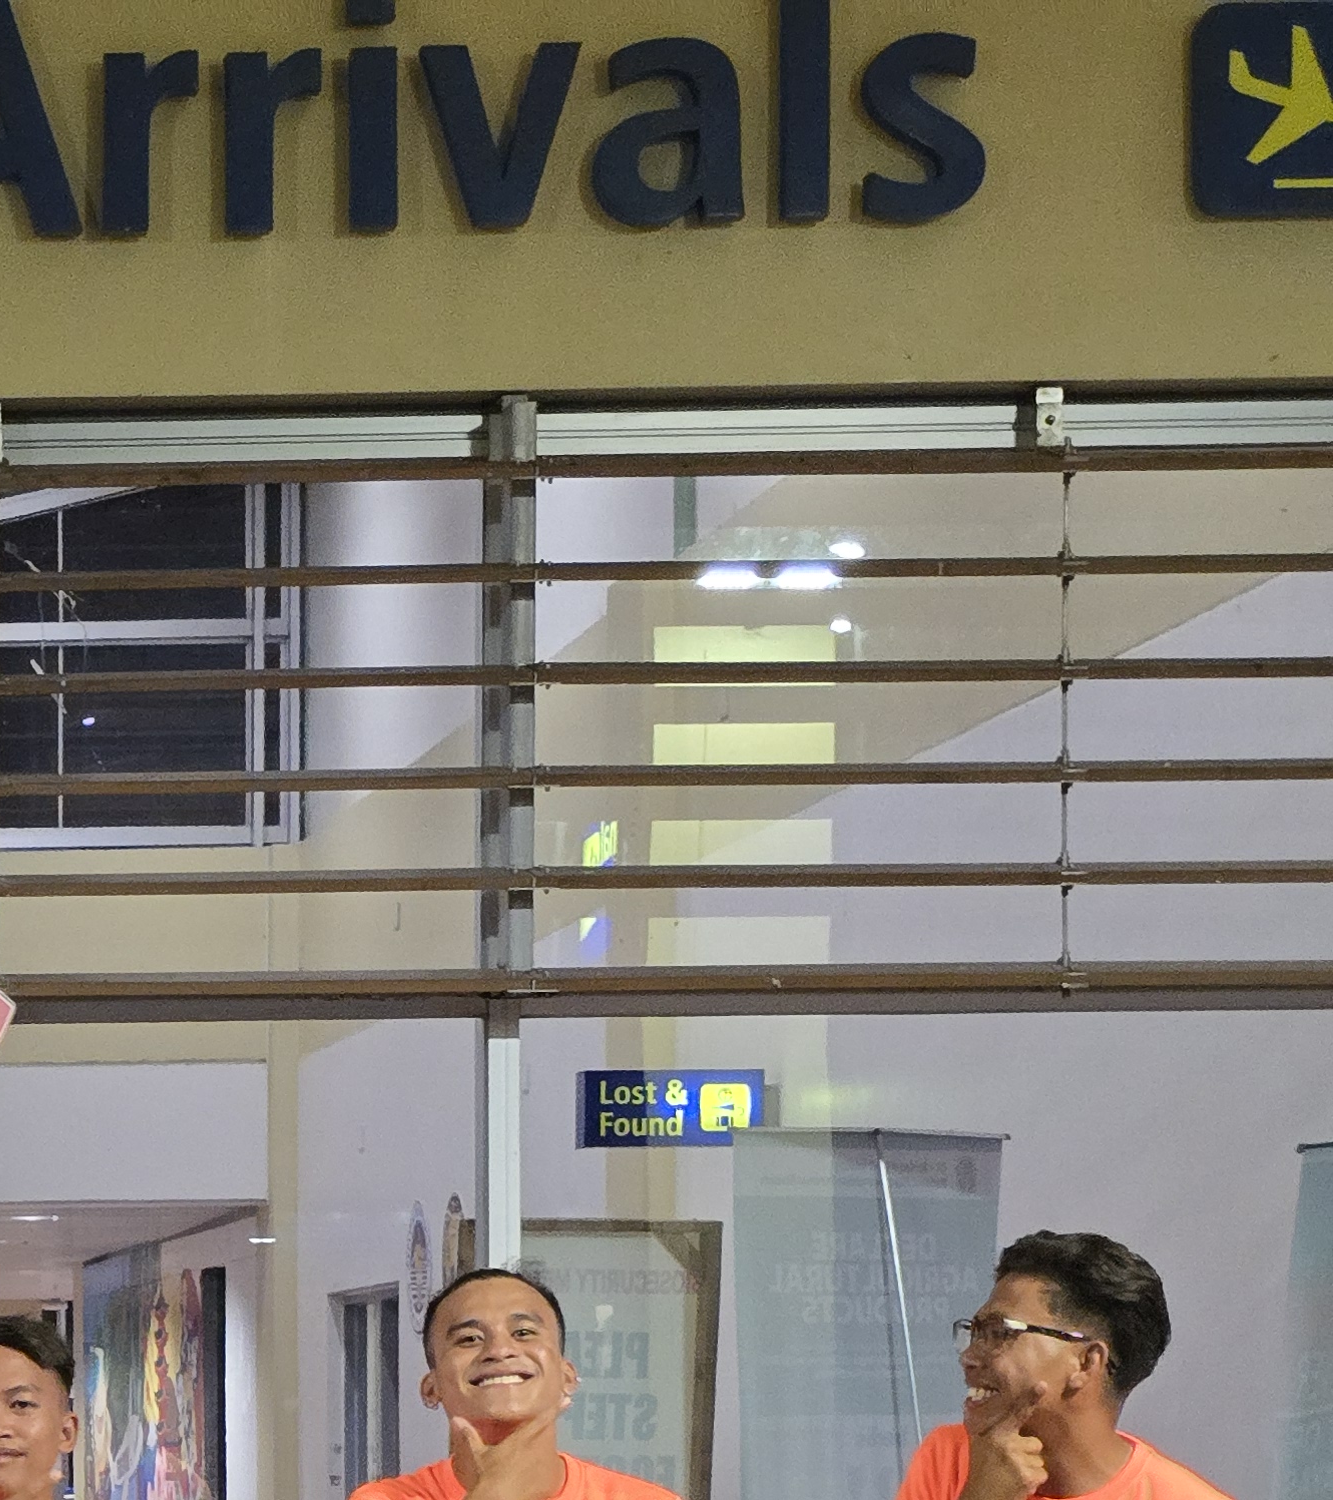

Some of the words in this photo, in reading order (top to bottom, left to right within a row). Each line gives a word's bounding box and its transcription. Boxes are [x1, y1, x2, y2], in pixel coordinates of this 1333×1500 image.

[599, 1080, 657, 1105] Lost
[665, 1079, 688, 1106] &
[599, 1109, 683, 1137] Found
